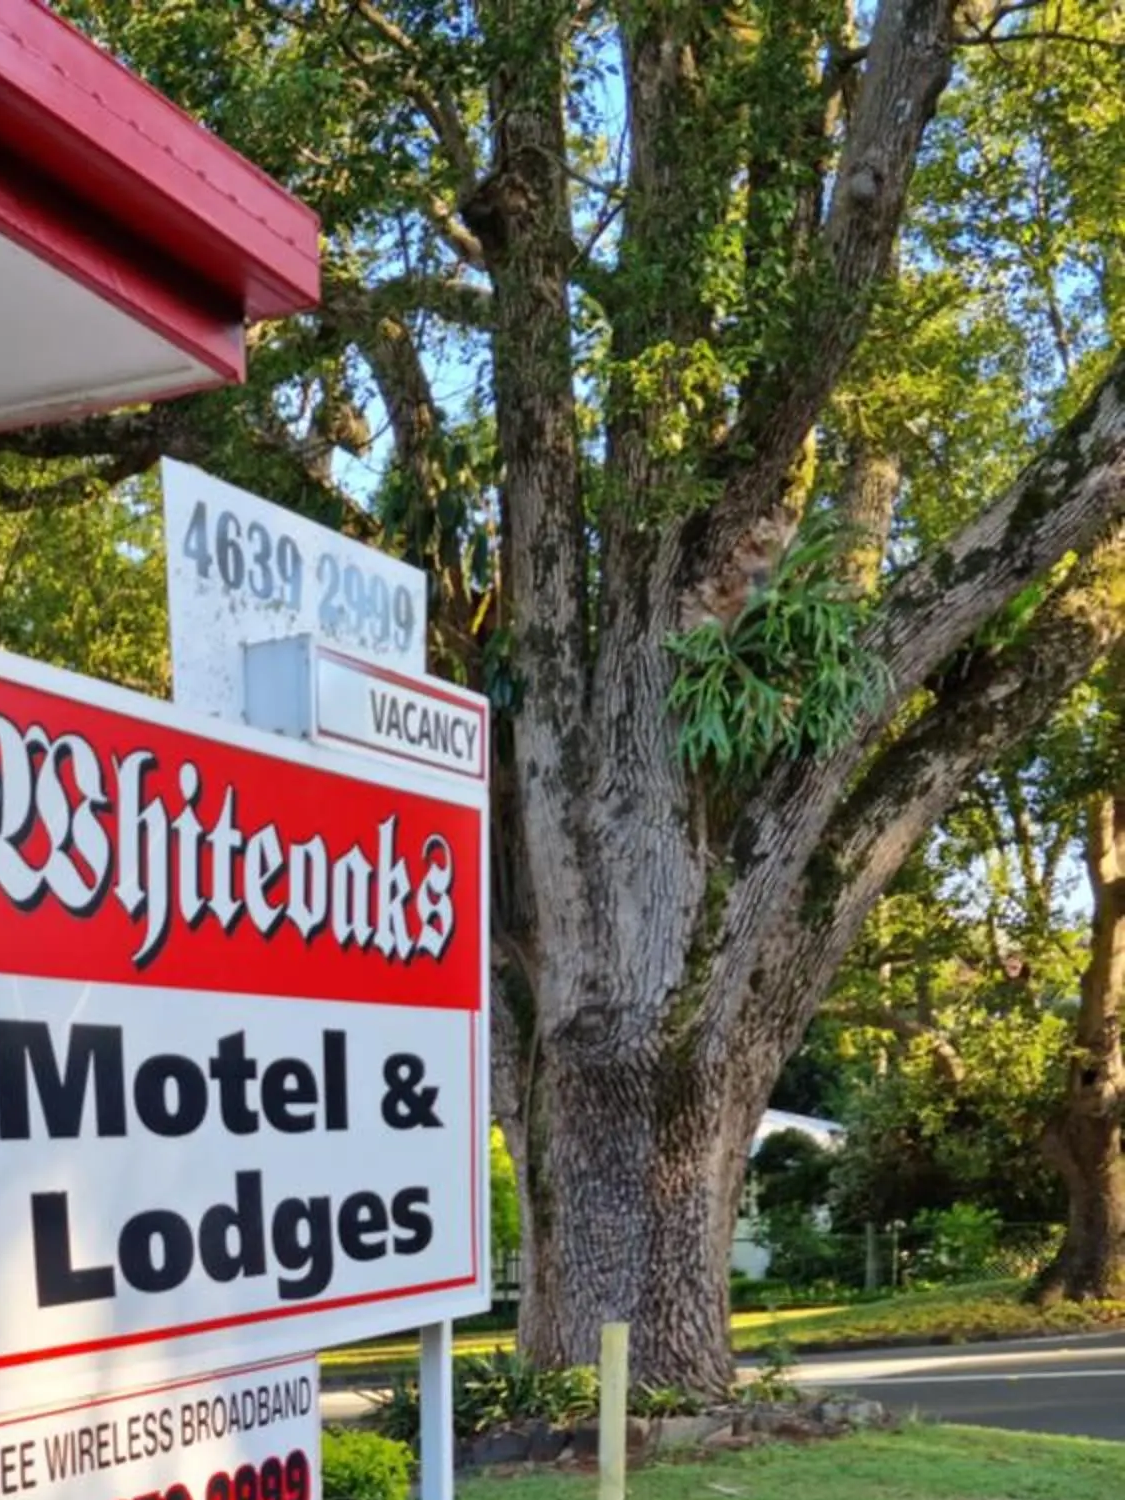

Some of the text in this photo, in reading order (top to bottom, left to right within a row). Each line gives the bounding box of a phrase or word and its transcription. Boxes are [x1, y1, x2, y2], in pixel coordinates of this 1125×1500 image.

[183, 500, 415, 653] 4639 2999
[370, 689, 478, 762] VACANCY
[380, 1052, 444, 1130] &
[30, 1168, 434, 1308] Lodges
[44, 1407, 174, 1483] WIRELESS
[180, 1375, 312, 1448] BROADBAND
